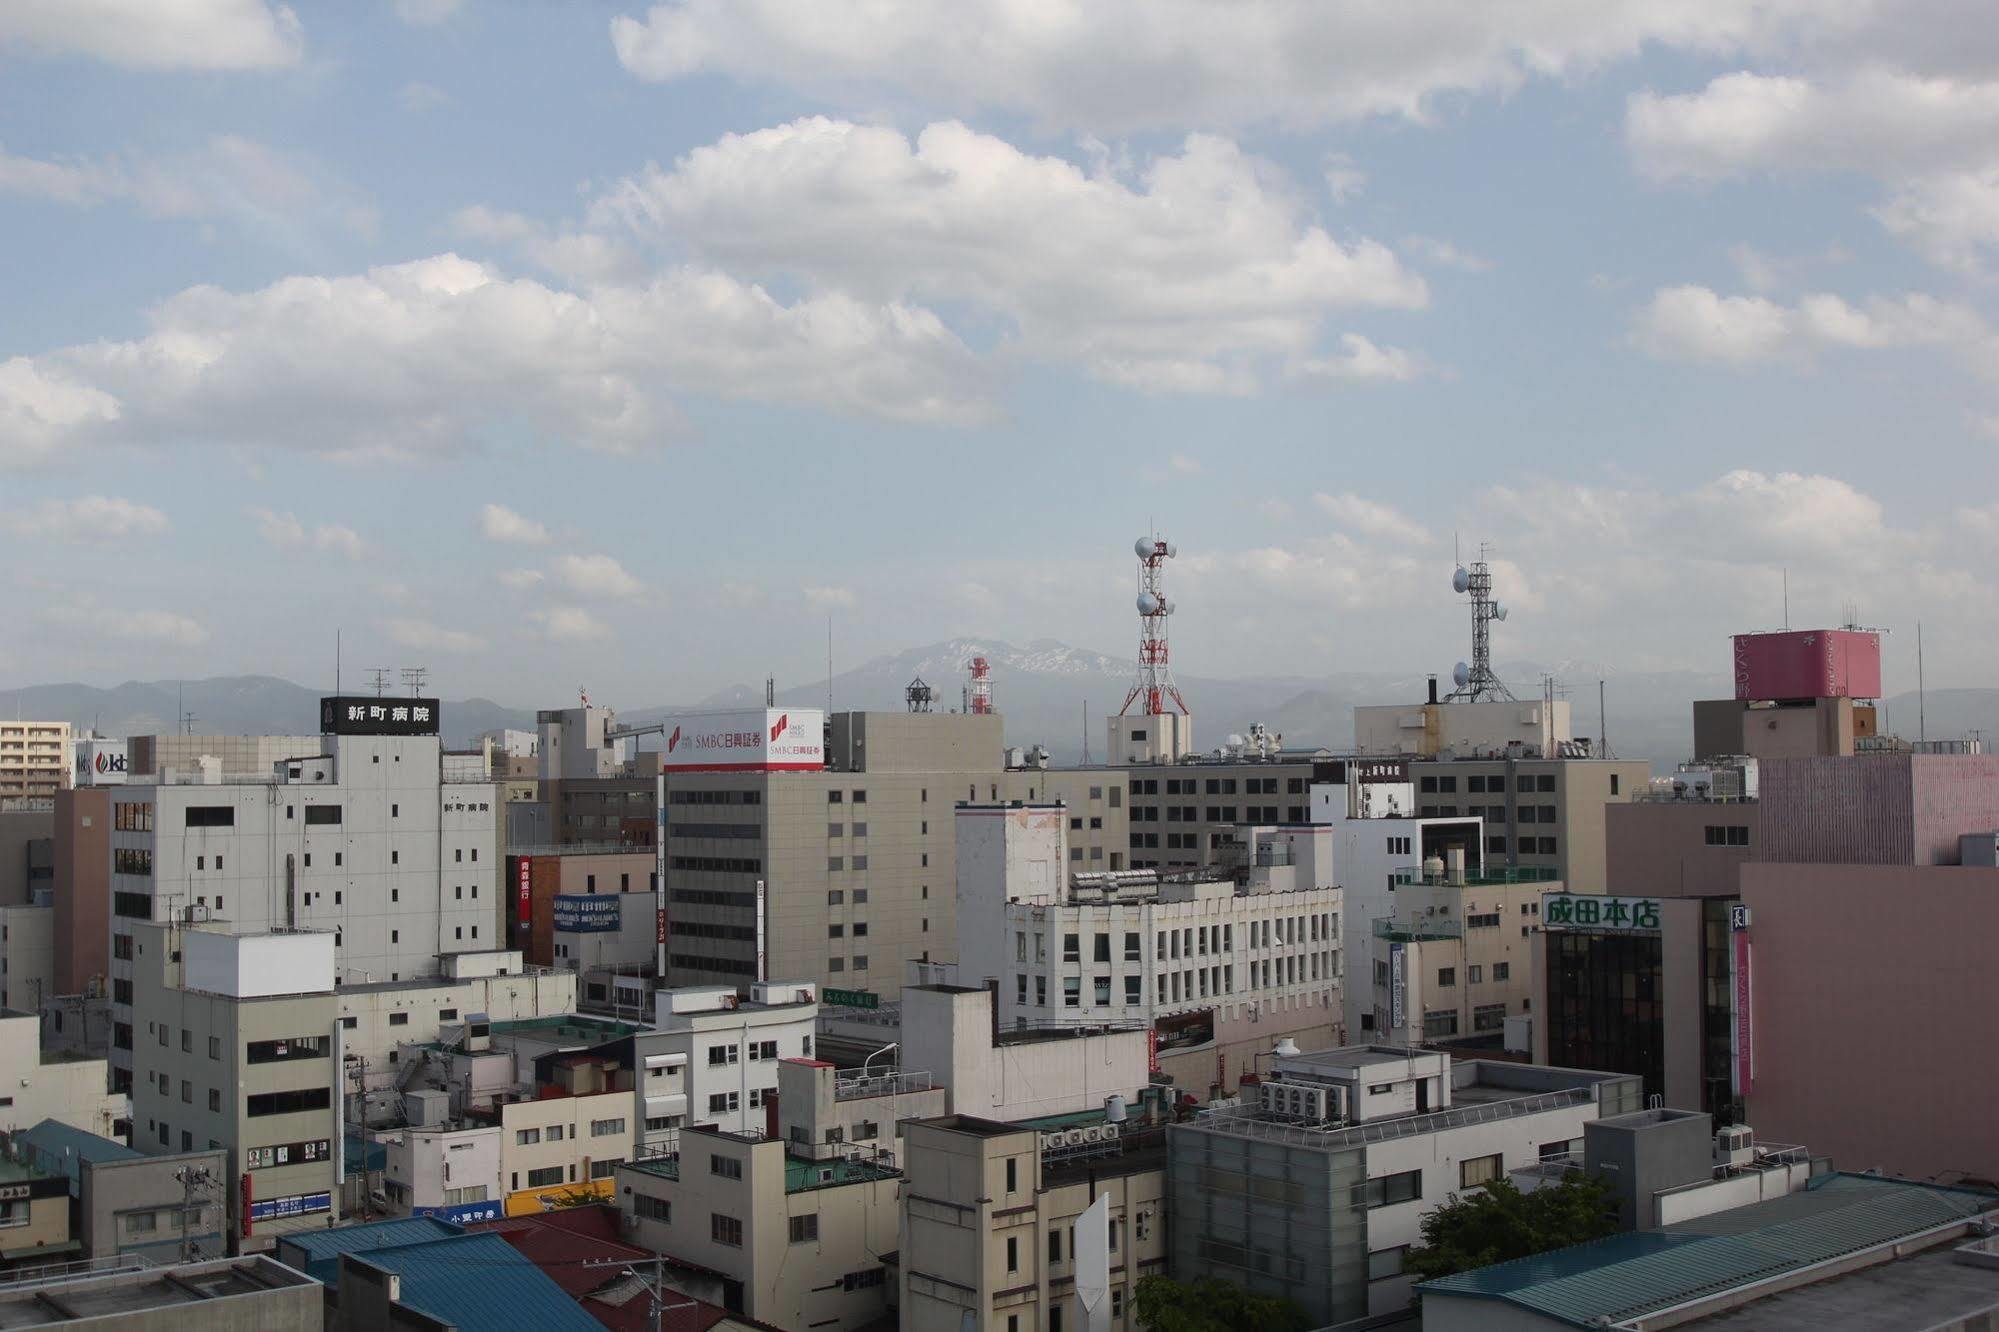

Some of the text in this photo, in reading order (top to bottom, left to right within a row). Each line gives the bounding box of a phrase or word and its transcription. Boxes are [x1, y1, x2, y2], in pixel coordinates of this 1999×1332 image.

[348, 706, 429, 721] 新町病院
[695, 732, 761, 749] SMBC日興証券
[770, 745, 820, 755] SMBC日興証券
[444, 803, 489, 812] 新町病院
[521, 861, 529, 899] 青森銀行
[1547, 897, 1660, 928] 成田本店
